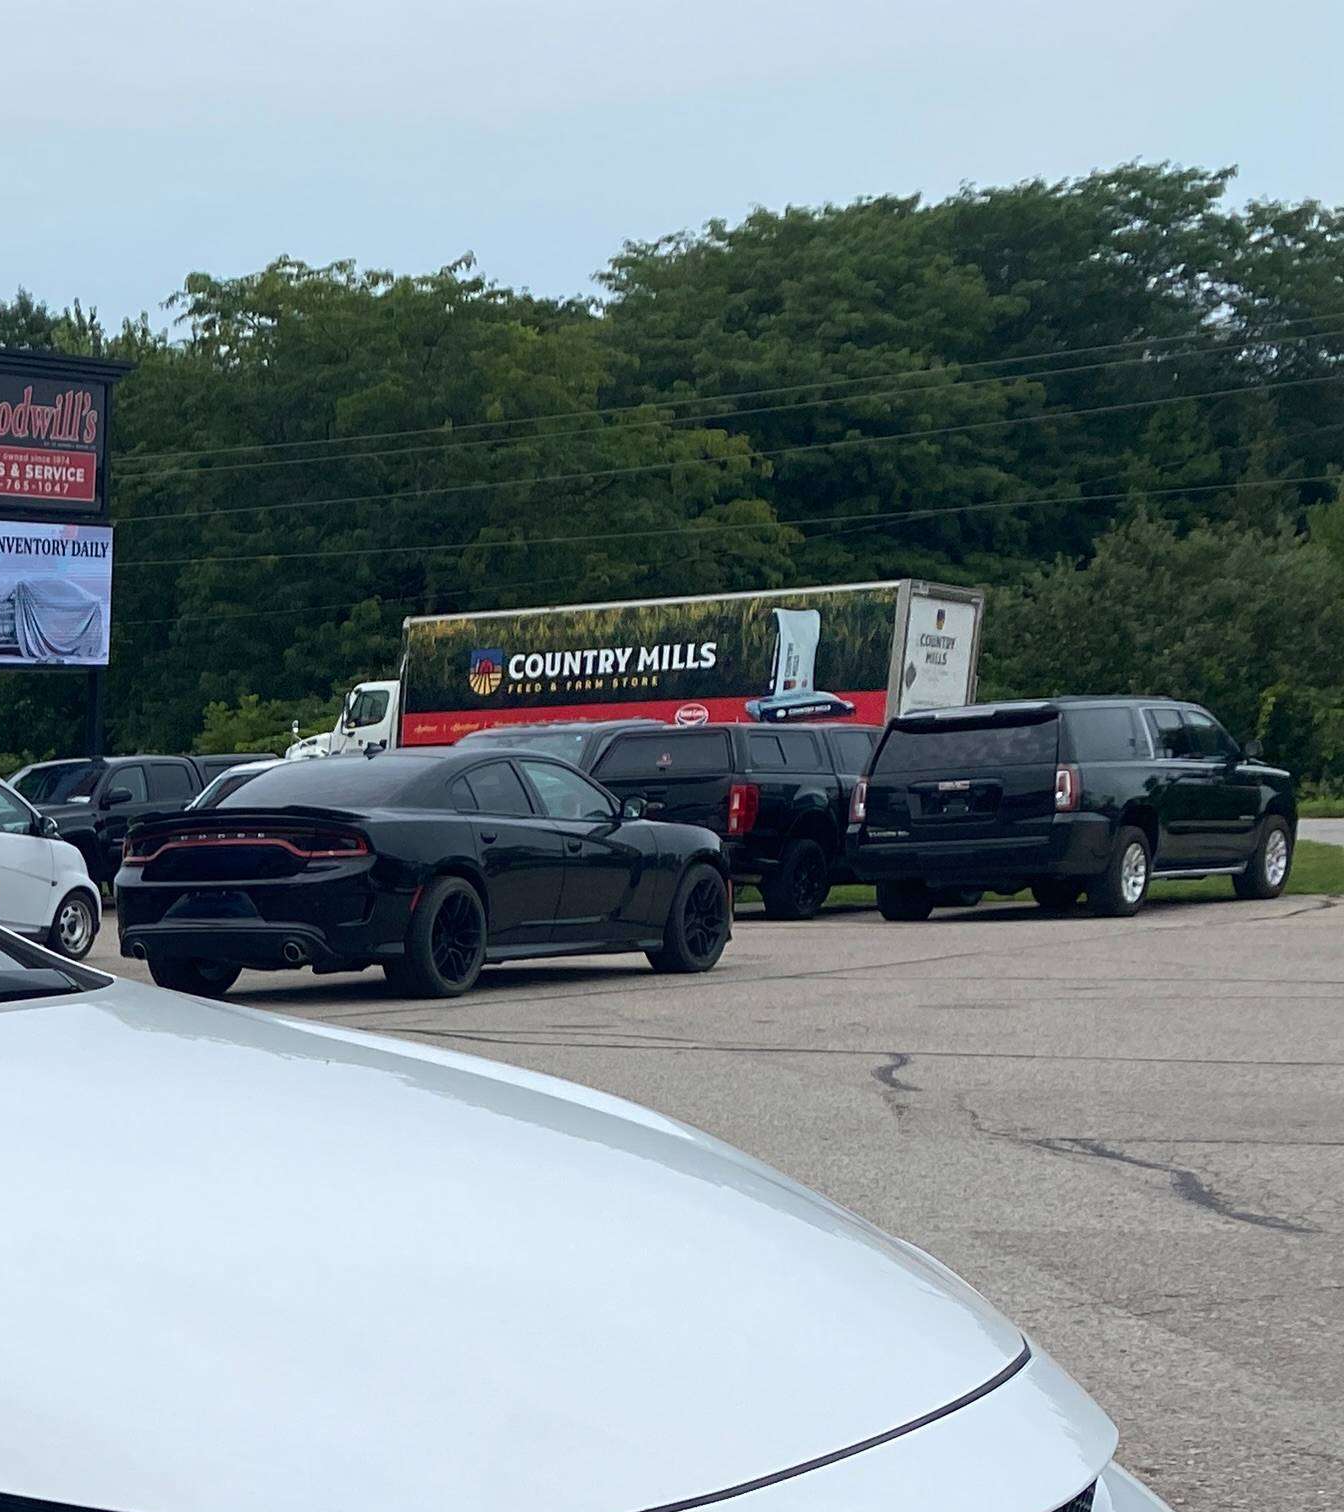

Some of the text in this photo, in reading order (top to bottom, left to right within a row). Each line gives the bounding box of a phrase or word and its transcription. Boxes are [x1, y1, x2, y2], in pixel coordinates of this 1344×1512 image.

[11, 462, 21, 478] &
[25, 463, 85, 482] SERVICE
[72, 540, 110, 559] DAILY
[920, 633, 957, 650] COUNTRY
[508, 642, 718, 680] COUNTRY MILLS
[508, 683, 542, 694] FEED
[566, 679, 604, 692] FARM
[612, 676, 659, 689] STORE
